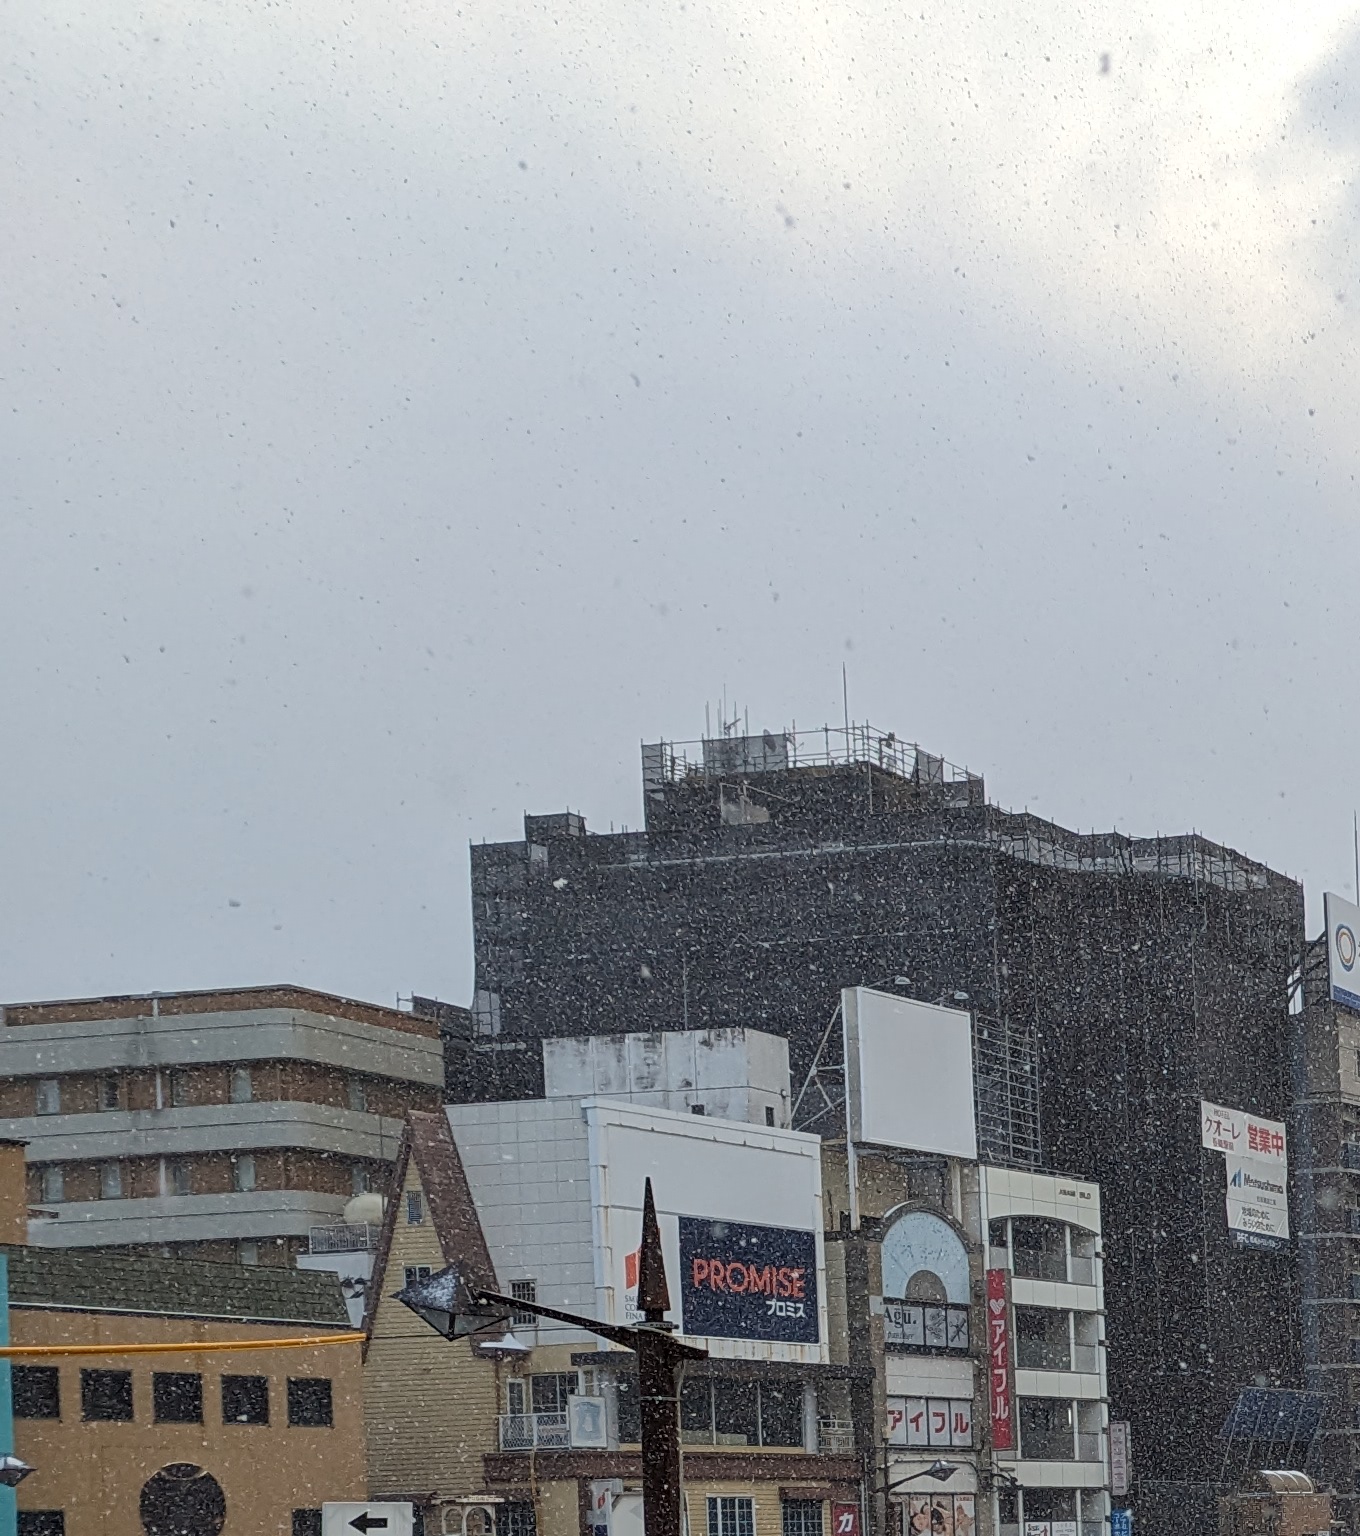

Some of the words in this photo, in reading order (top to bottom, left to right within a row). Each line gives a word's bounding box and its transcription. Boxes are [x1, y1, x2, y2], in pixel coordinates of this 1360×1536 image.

[1204, 1115, 1241, 1141] クオーレ
[1247, 1123, 1285, 1157] 営業中
[692, 1258, 806, 1299] PROMISE
[765, 1299, 807, 1319] プロミス
[991, 1319, 1009, 1420] アイフル
[887, 1409, 970, 1434] アイフル
